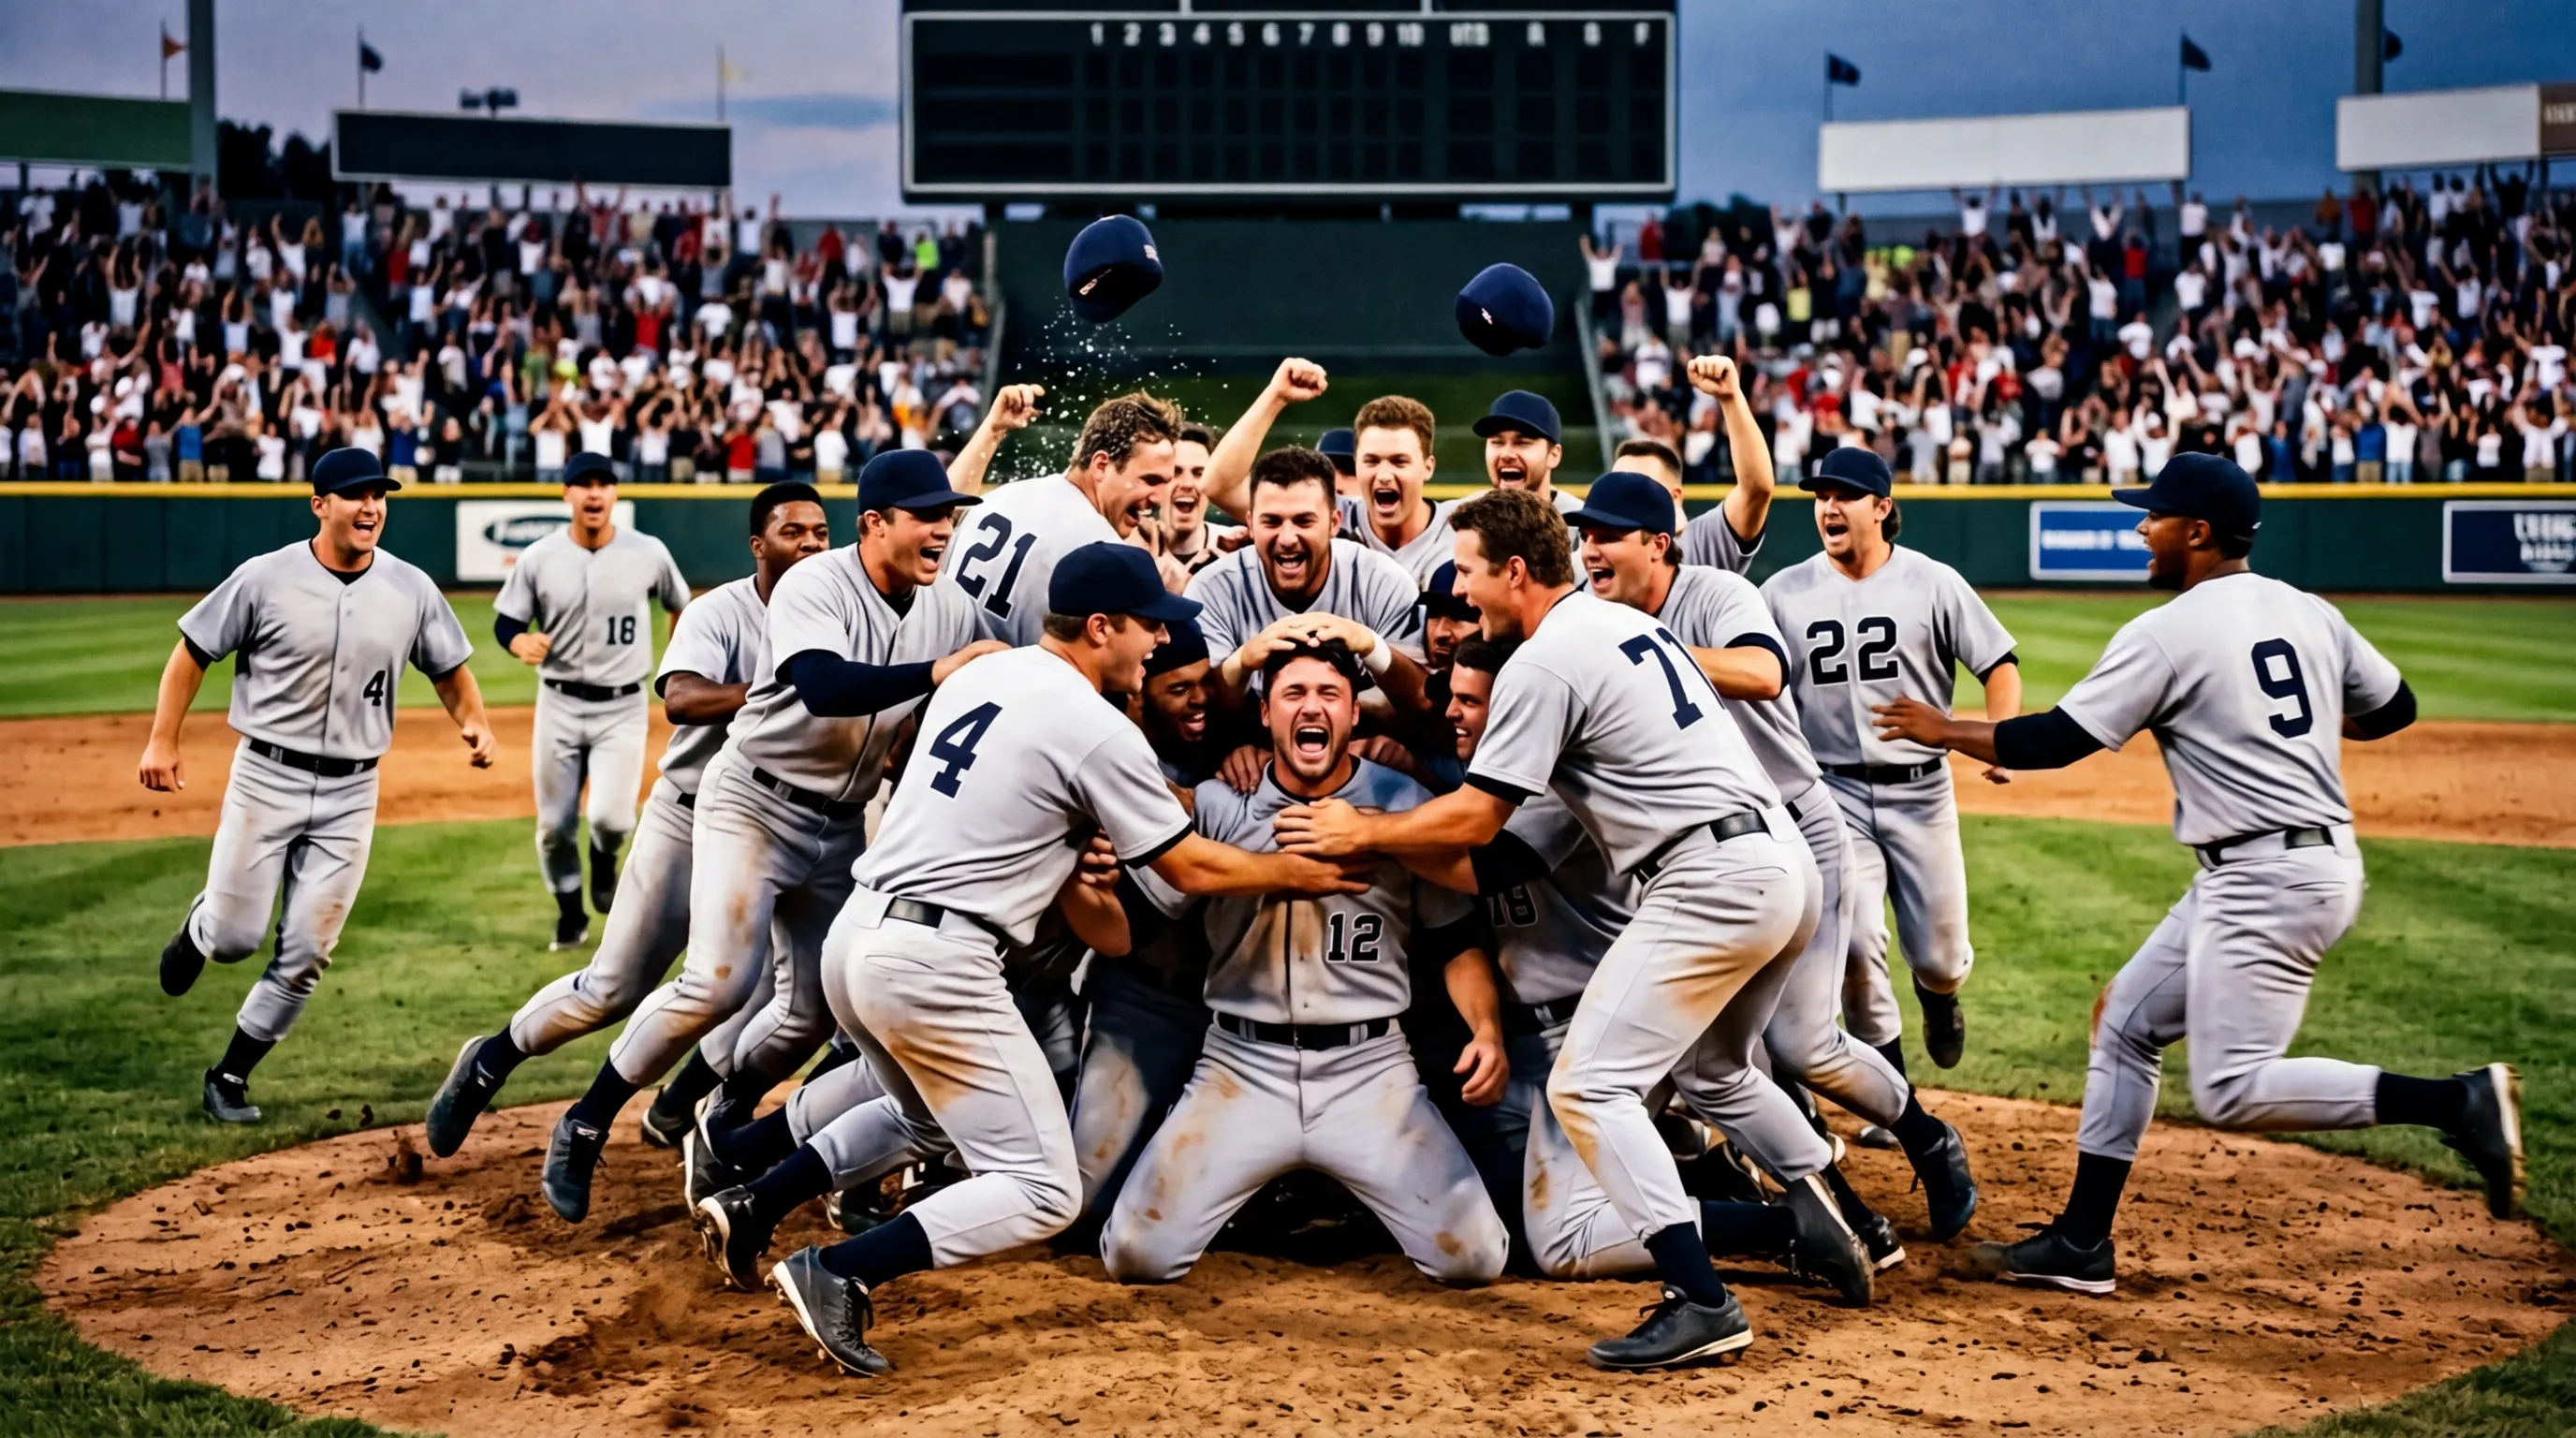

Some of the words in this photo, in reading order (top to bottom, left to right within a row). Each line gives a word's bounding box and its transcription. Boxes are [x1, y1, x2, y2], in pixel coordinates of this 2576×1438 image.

[1091, 22, 1104, 45] 1
[1124, 22, 1141, 46] 2
[1160, 22, 1176, 46] 3
[1193, 22, 1210, 45] 4
[1228, 22, 1244, 46] 5
[1298, 22, 1314, 45] 7
[955, 512, 1038, 620] 21
[607, 616, 637, 645] 18
[1806, 616, 1899, 685] 22
[362, 669, 387, 707] 4
[2250, 638, 2314, 739] 9
[928, 701, 1003, 800] 4
[1326, 912, 1383, 962] 12
